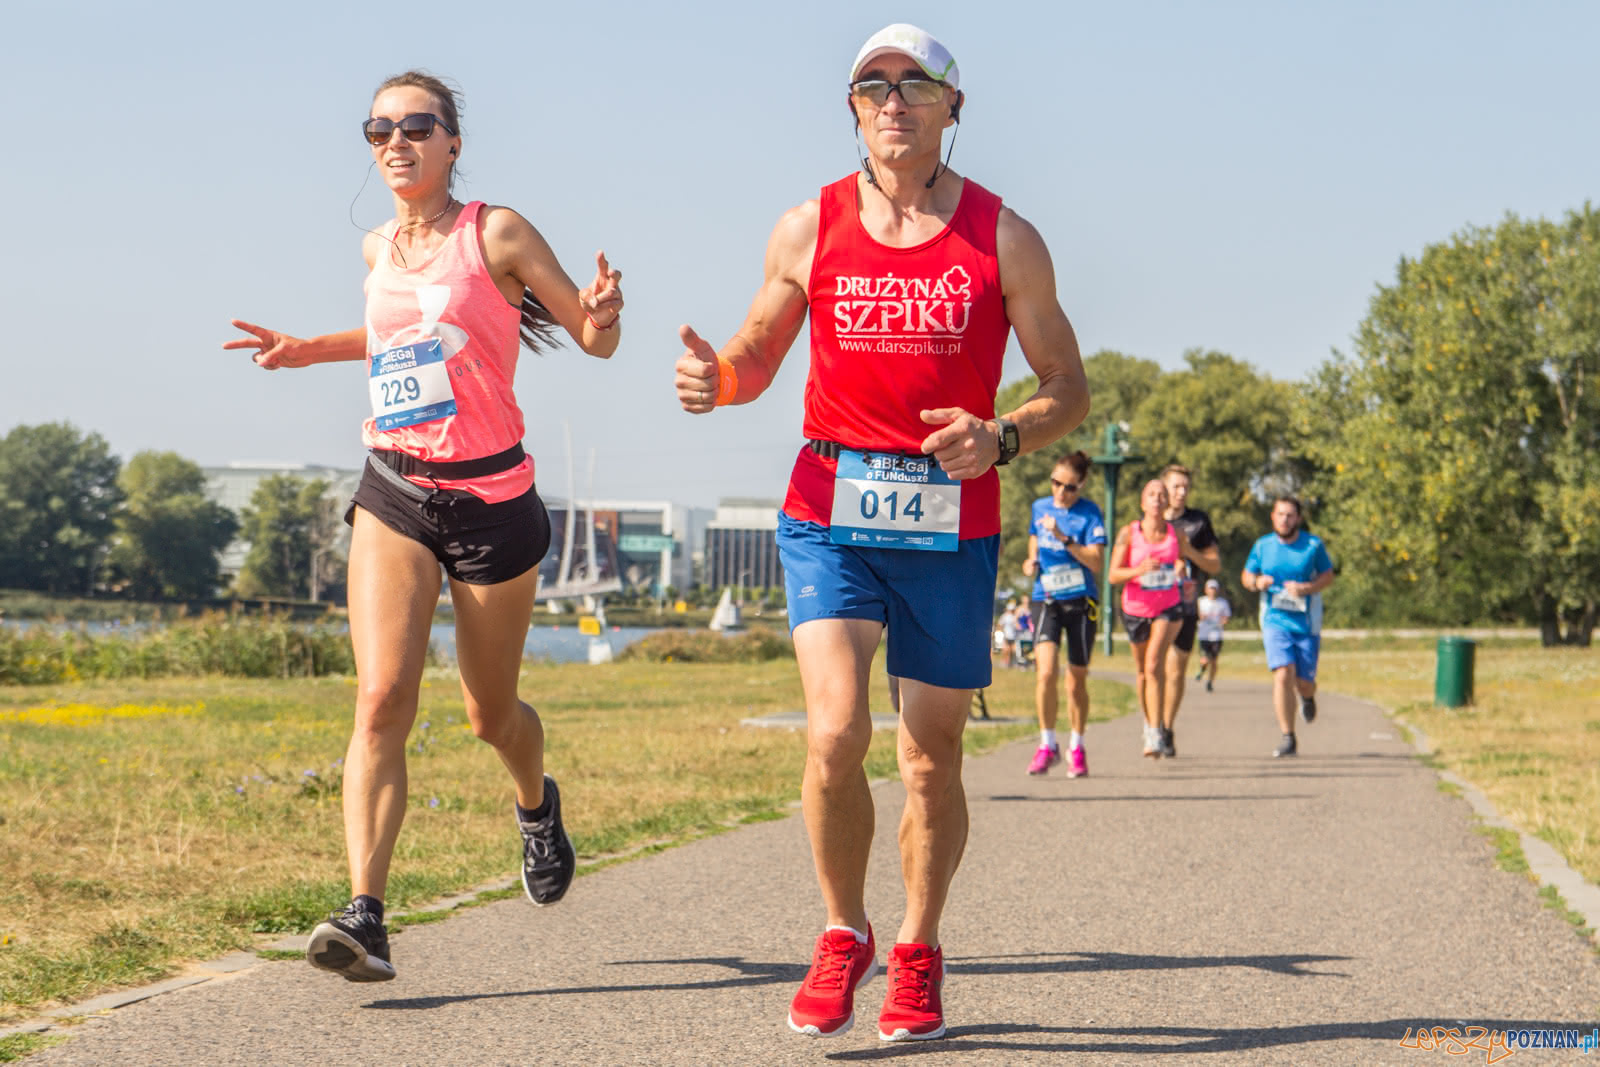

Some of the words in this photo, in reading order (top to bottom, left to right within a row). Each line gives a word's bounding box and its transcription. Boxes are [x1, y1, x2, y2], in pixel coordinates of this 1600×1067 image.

[834, 272, 949, 299] DRUŻYNA
[834, 299, 972, 334] SZPIKU
[838, 339, 961, 356] www.darszpiku.pl
[381, 376, 421, 407] 229
[875, 470, 929, 483] FUNdusze
[860, 489, 925, 522] 014
